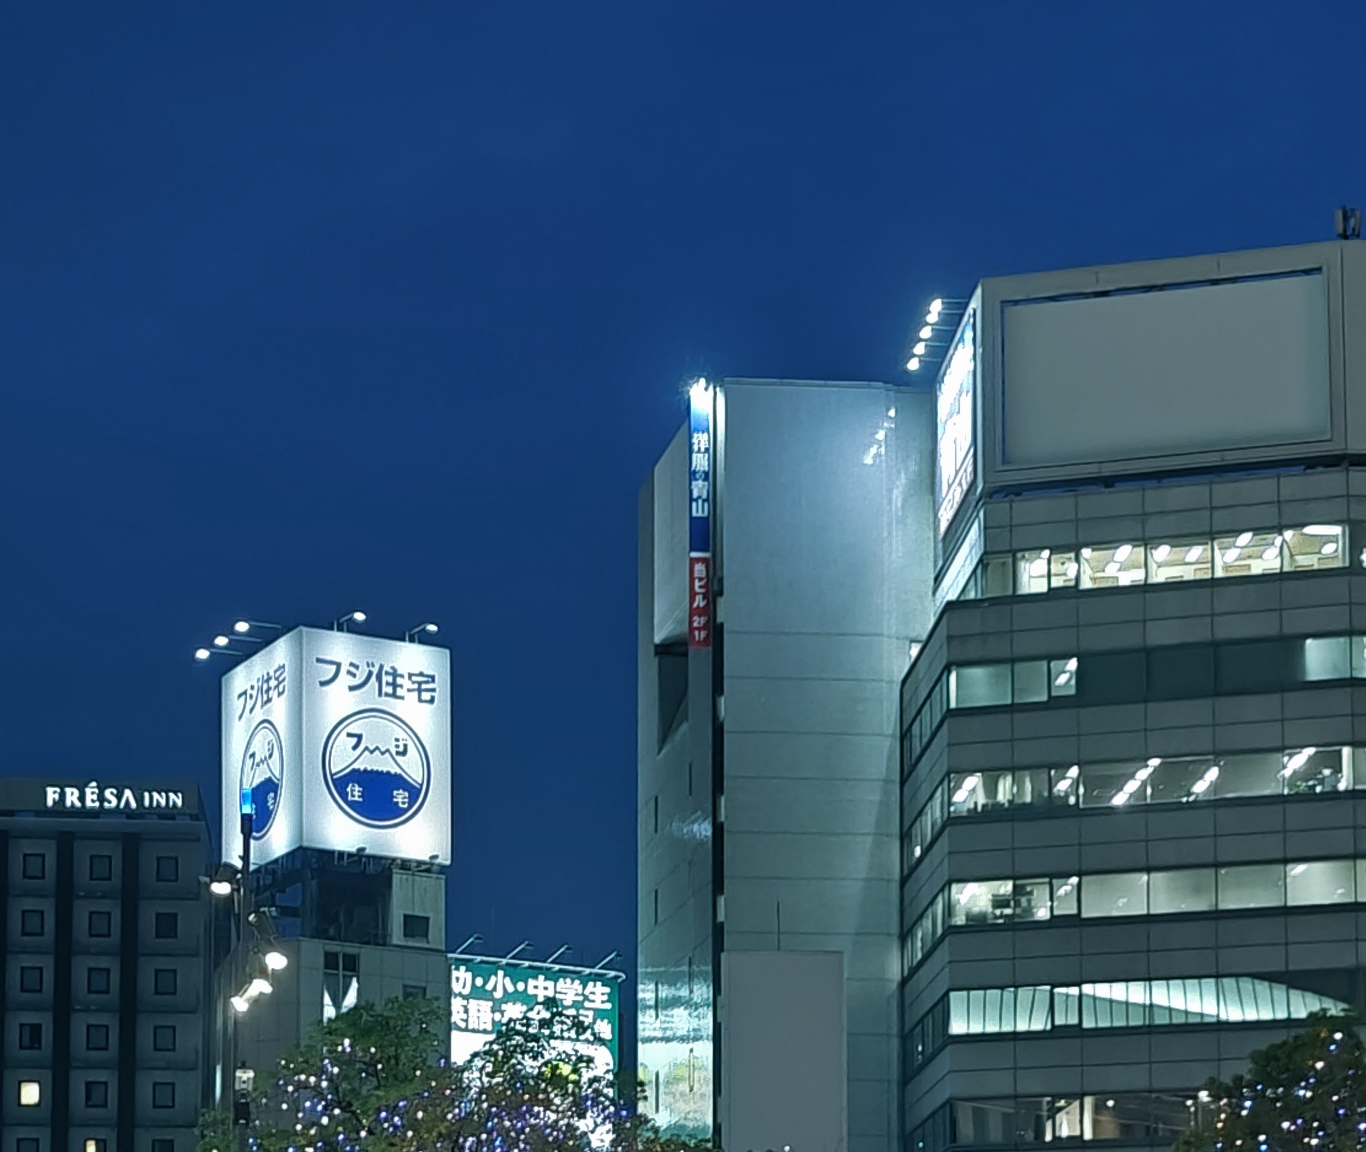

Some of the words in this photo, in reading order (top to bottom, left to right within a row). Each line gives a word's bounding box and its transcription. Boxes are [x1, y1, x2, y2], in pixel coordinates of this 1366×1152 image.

[237, 663, 287, 722] フジ住宅
[315, 656, 437, 705] フジ住宅
[45, 780, 137, 810] FRÉSA
[143, 791, 183, 808] INN
